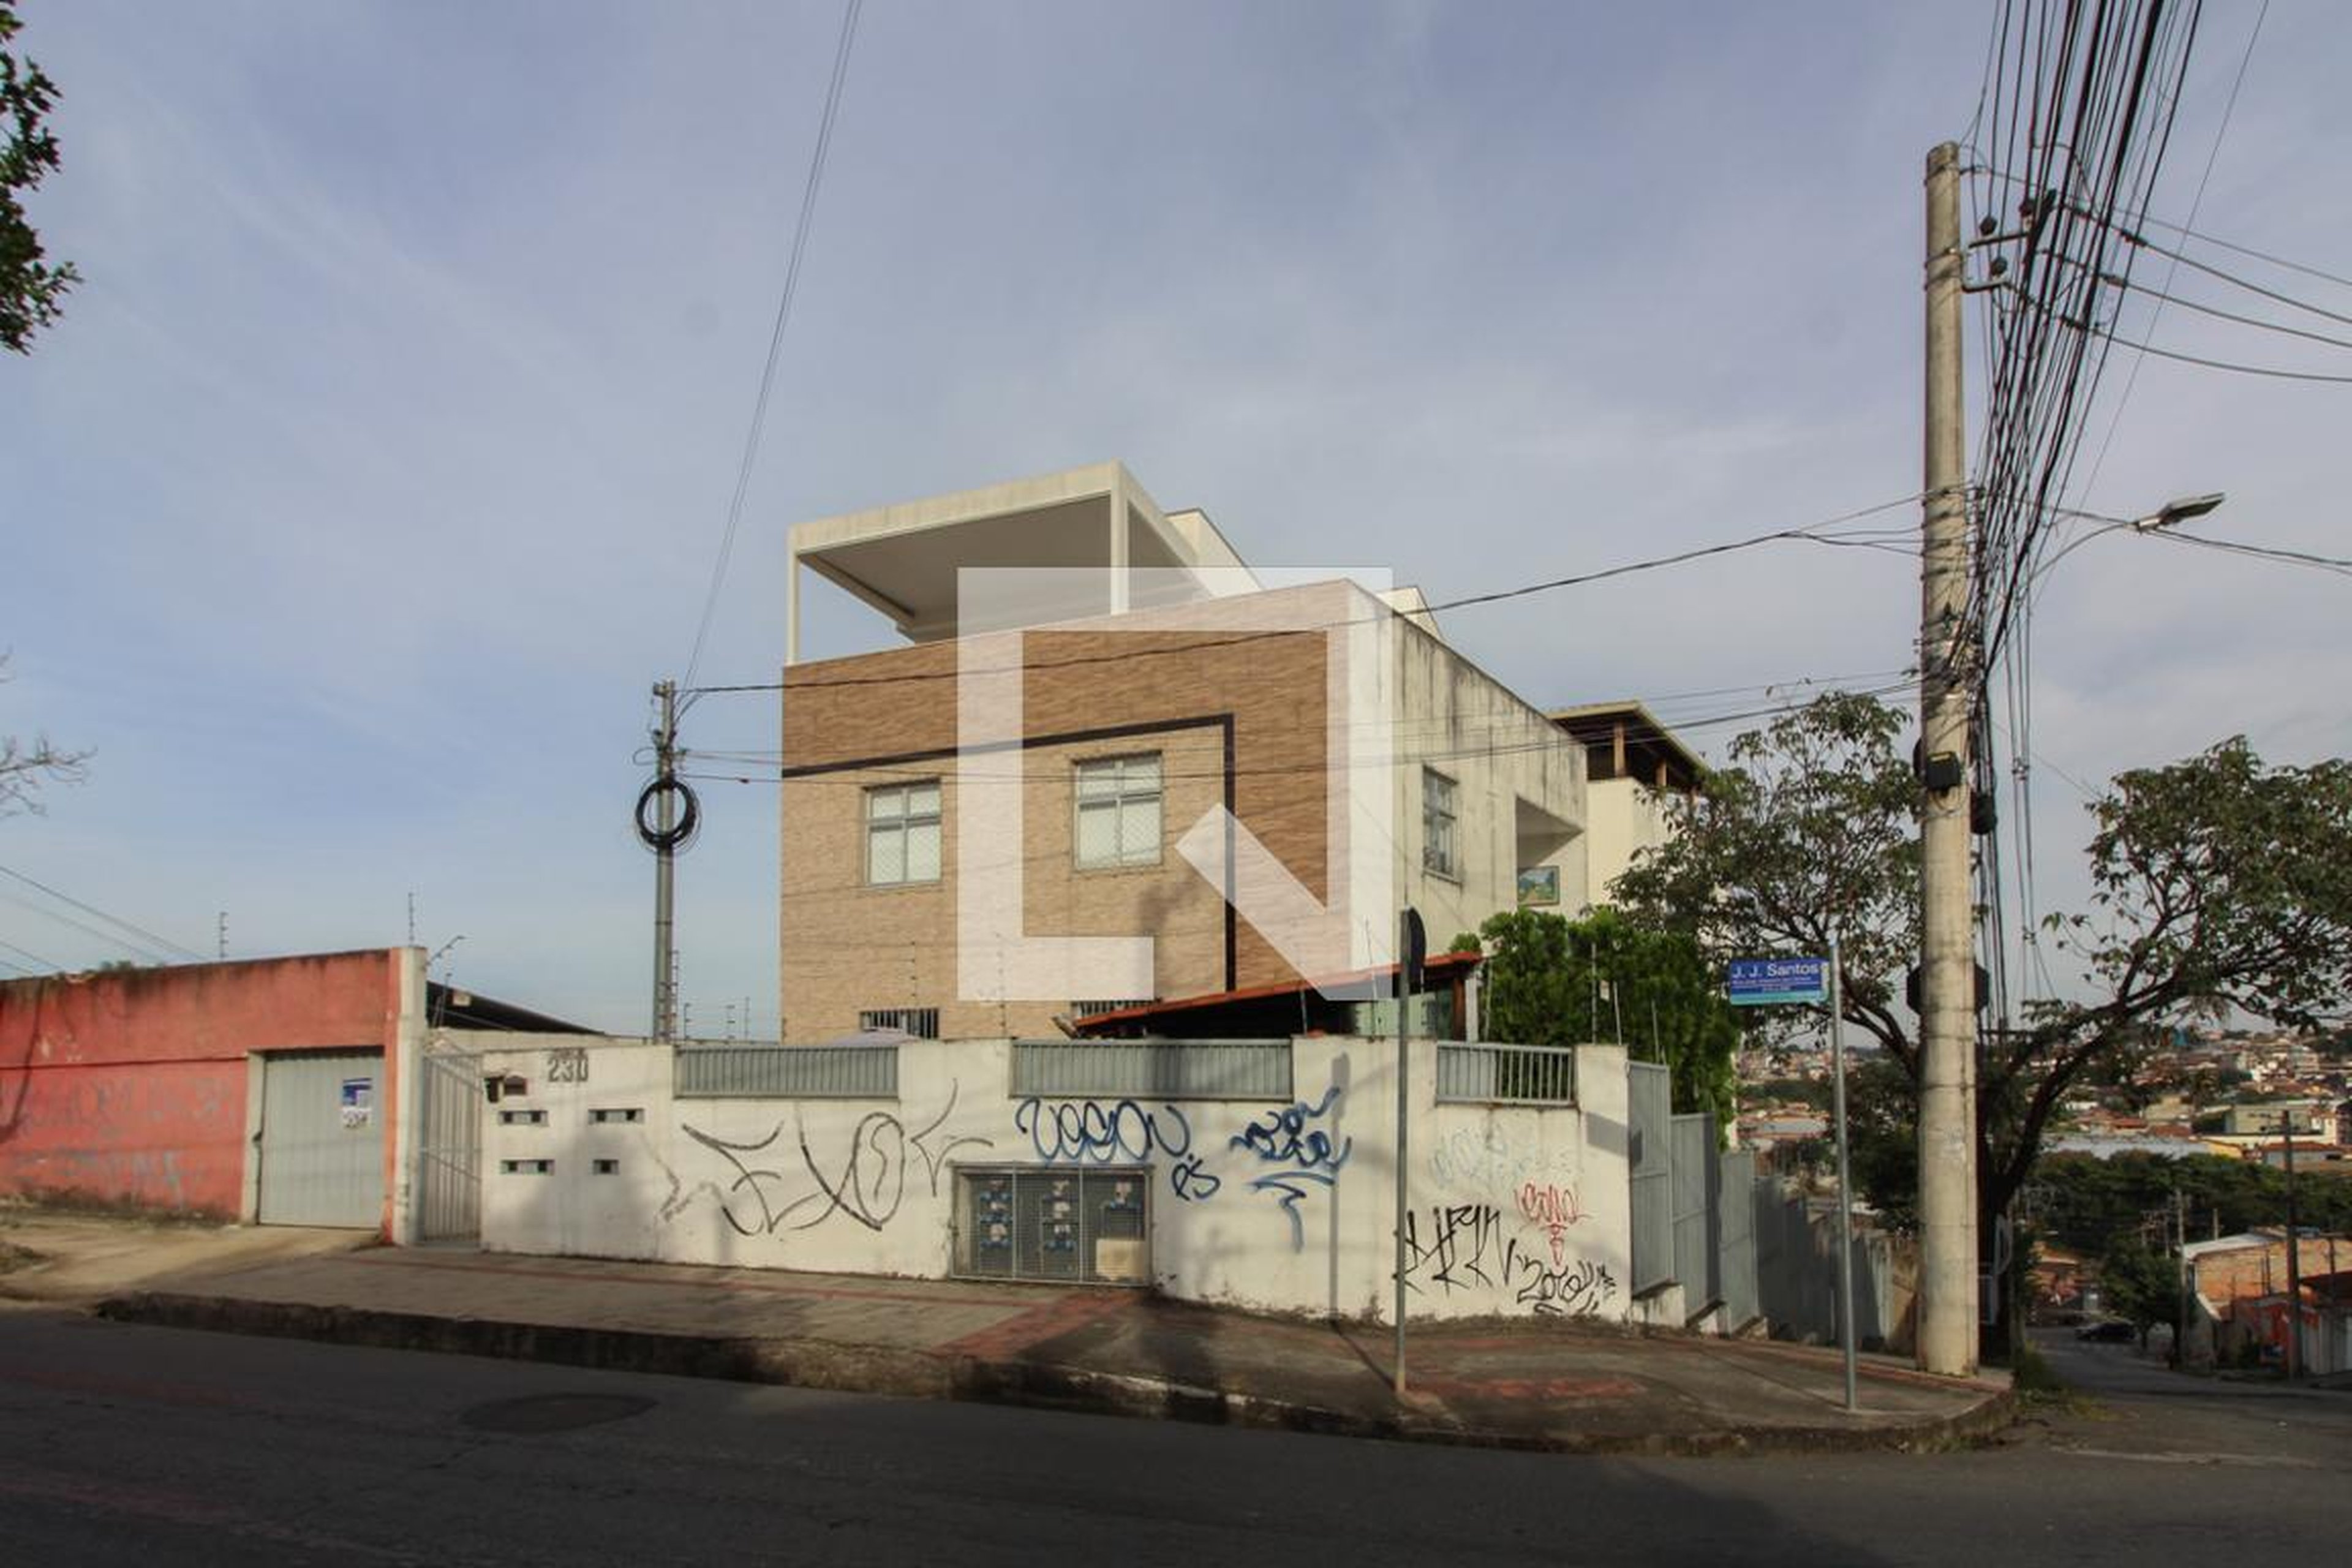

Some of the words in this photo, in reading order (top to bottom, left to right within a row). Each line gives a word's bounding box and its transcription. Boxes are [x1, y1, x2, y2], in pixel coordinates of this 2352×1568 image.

[1732, 965, 1746, 979] J.
[1749, 964, 1763, 978] J.
[1767, 962, 1820, 977] Santos
